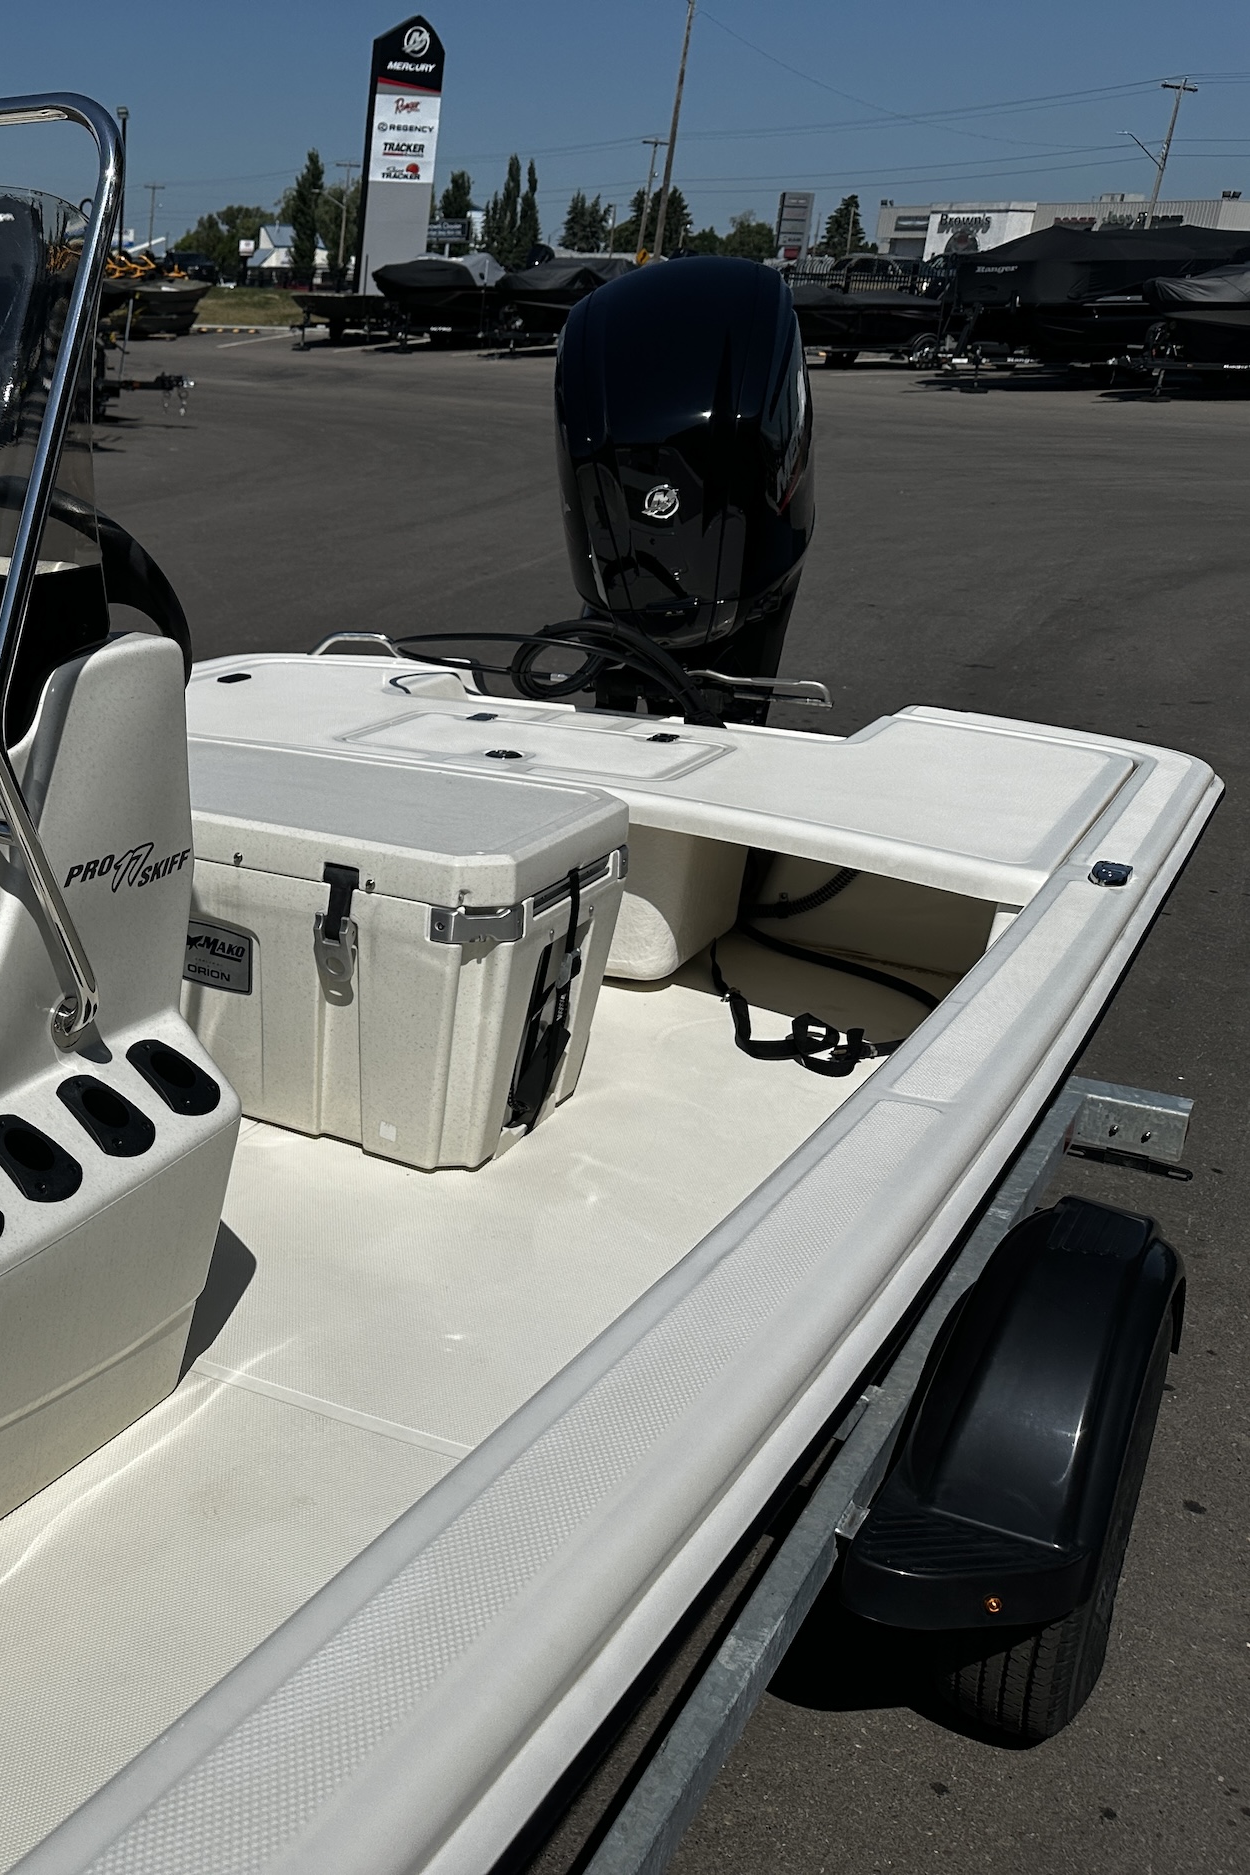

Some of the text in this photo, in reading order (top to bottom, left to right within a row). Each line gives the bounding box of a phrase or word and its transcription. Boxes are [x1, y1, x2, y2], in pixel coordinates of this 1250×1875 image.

[387, 61, 436, 72] MERCURY
[389, 123, 434, 133] REGENCY
[383, 142, 425, 153] TRACKER
[381, 172, 420, 180] TRACKER
[939, 213, 991, 226] Brown's
[975, 265, 1018, 274] Ranger
[64, 854, 115, 888] PRO
[138, 848, 191, 887] SKIFF
[197, 935, 245, 962] MAKO
[187, 963, 230, 982] ORION
